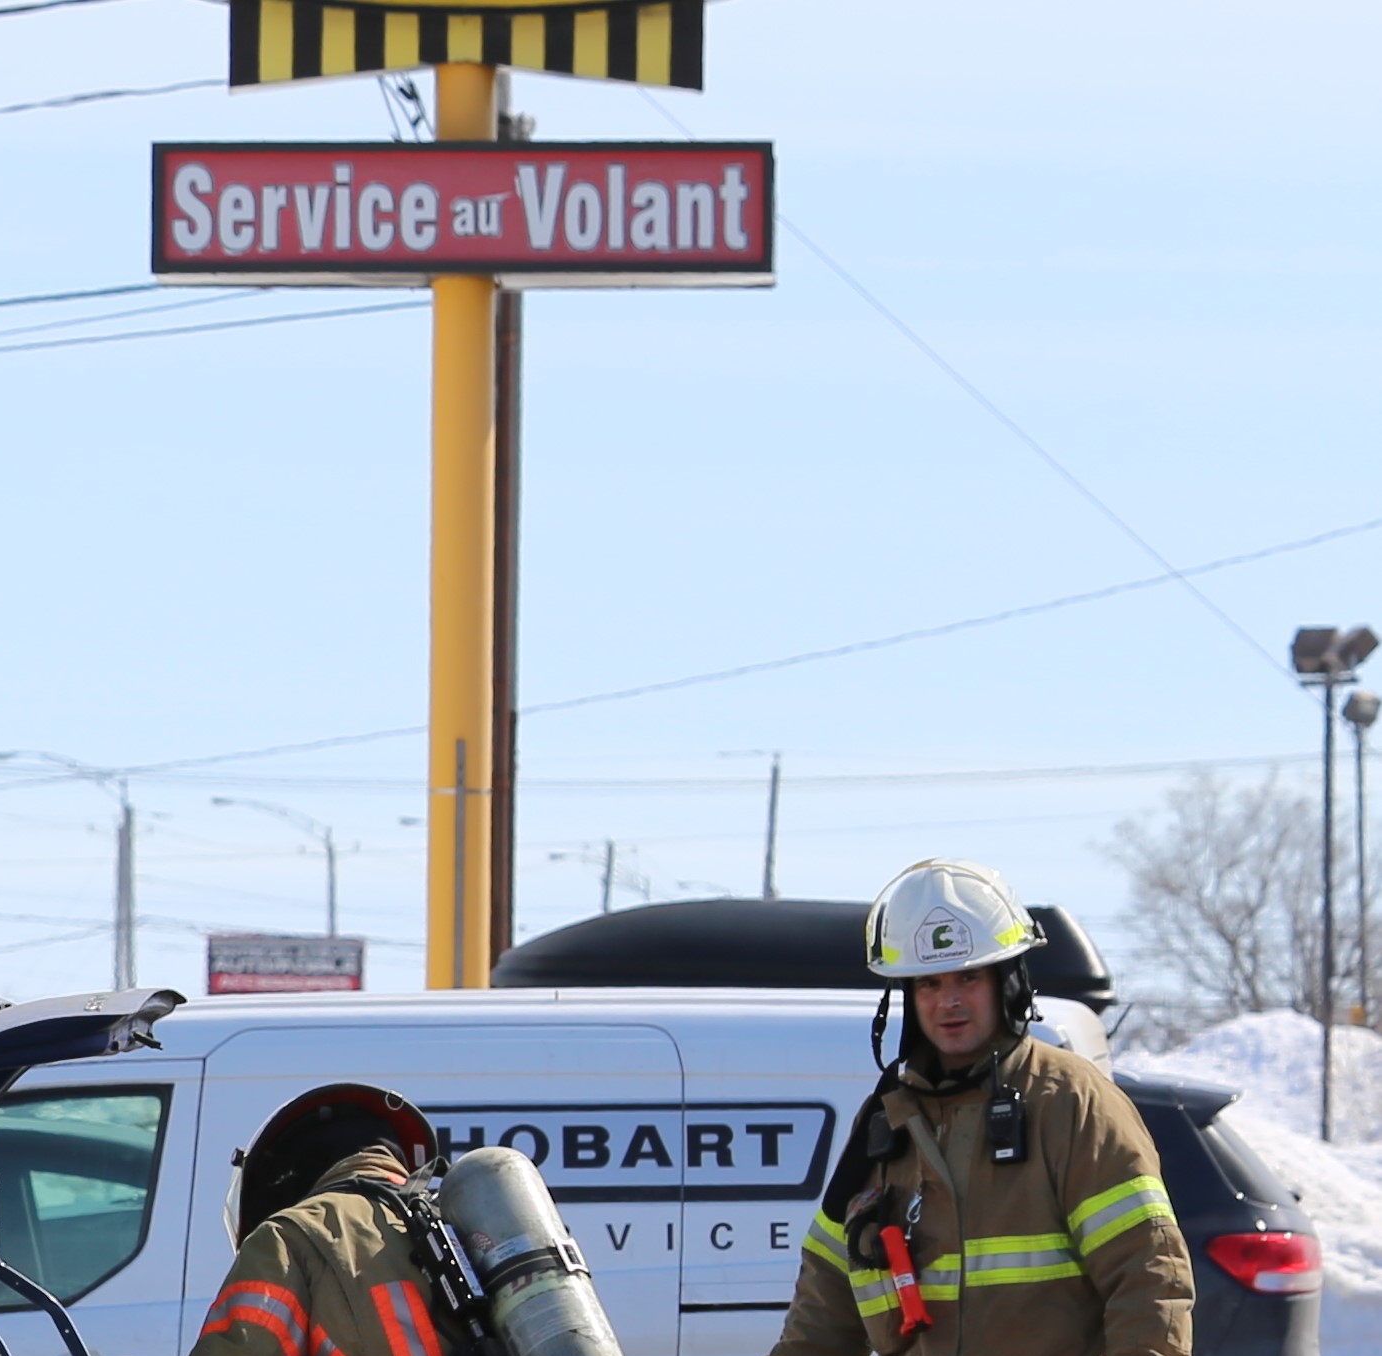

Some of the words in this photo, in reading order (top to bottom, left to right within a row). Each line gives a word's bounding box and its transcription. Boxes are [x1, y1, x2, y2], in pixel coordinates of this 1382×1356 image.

[171, 162, 437, 253] Service
[450, 196, 502, 238] au
[516, 162, 749, 252] Volant
[437, 1123, 794, 1168] HOBART
